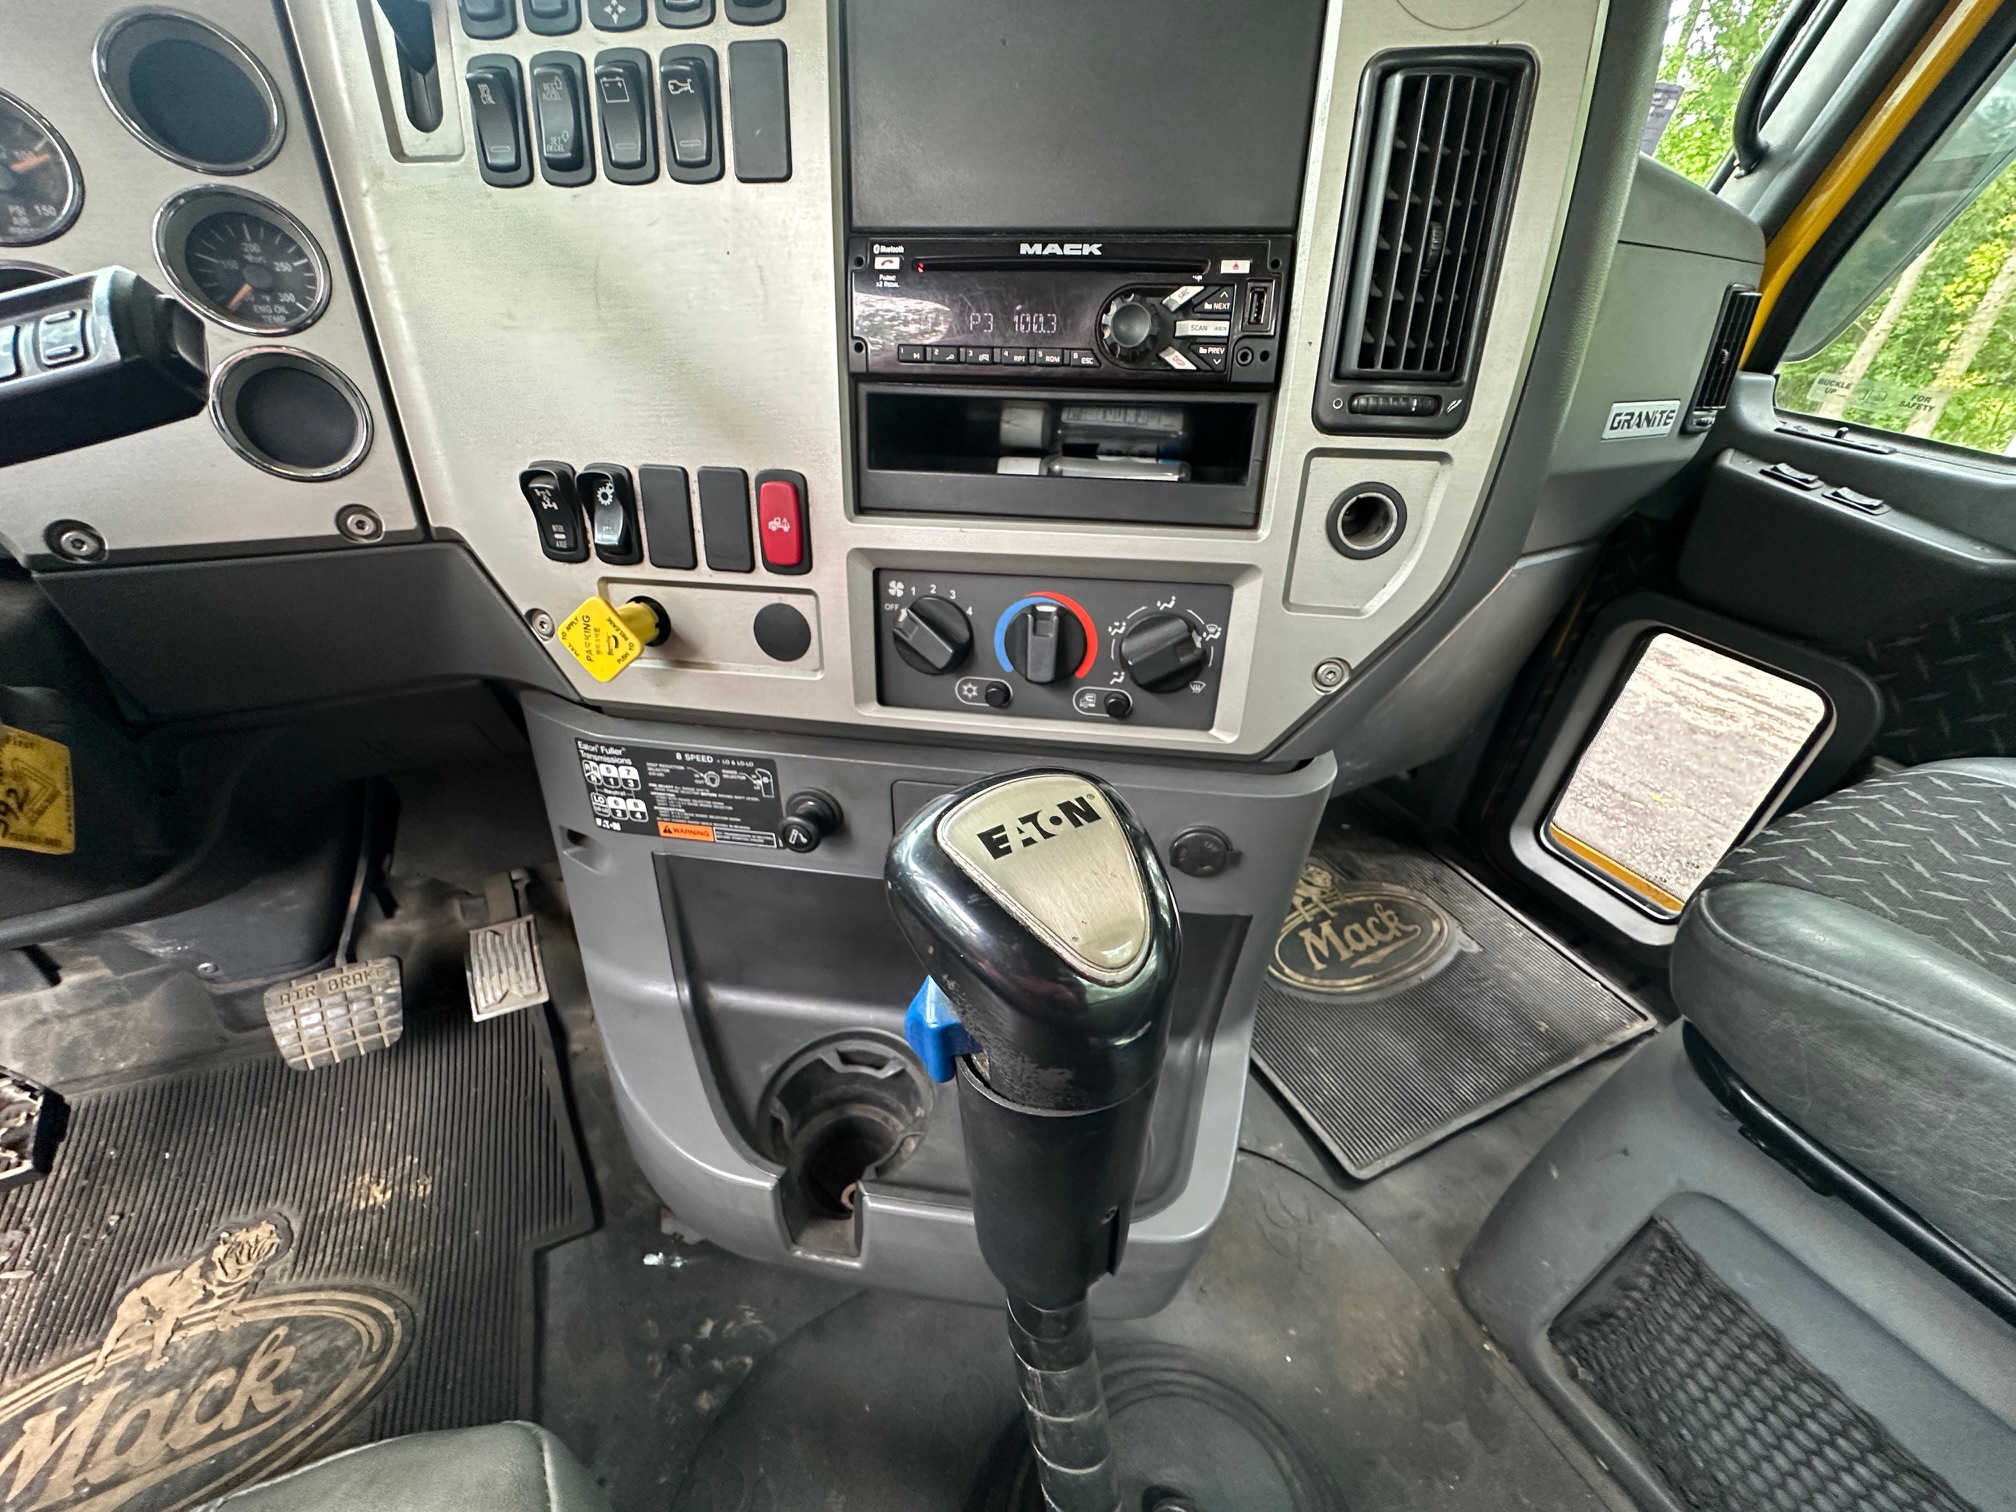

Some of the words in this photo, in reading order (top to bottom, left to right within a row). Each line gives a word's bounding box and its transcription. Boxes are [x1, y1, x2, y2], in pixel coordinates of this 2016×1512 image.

[33, 204, 58, 217] 150
[242, 243, 261, 253] 200
[1019, 243, 1103, 256] MACK
[274, 262, 292, 272] 250
[278, 293, 296, 303] 300
[253, 305, 273, 314] ENG
[1213, 302, 1231, 310] NEXT
[969, 313, 994, 333] P3
[1190, 324, 1208, 332] SCAN
[1817, 378, 1853, 390] BUCKLE
[1824, 387, 1837, 395] UP
[1910, 394, 1933, 404] FOR
[1898, 400, 1937, 413] SAFETY
[1609, 410, 1676, 431] GRANITE
[910, 586, 916, 596] 1
[930, 584, 937, 594] 2
[950, 590, 956, 600] 3
[884, 602, 900, 612] OFF
[966, 606, 973, 616] 4
[566, 616, 579, 632] APPLY
[606, 616, 630, 642] RELEASE
[582, 614, 594, 662] PARKING
[628, 642, 635, 652] TO
[577, 741, 598, 753] Eaton
[600, 745, 623, 756] Fuller
[579, 750, 632, 766] Transmissions
[684, 754, 714, 764] SPEED
[592, 794, 605, 804] LO
[672, 826, 710, 838] WARNING
[976, 794, 1102, 860] EATON
[1298, 902, 1422, 971] Mack
[327, 967, 387, 992] BRAKE
[0, 1323, 304, 1503] Mack
